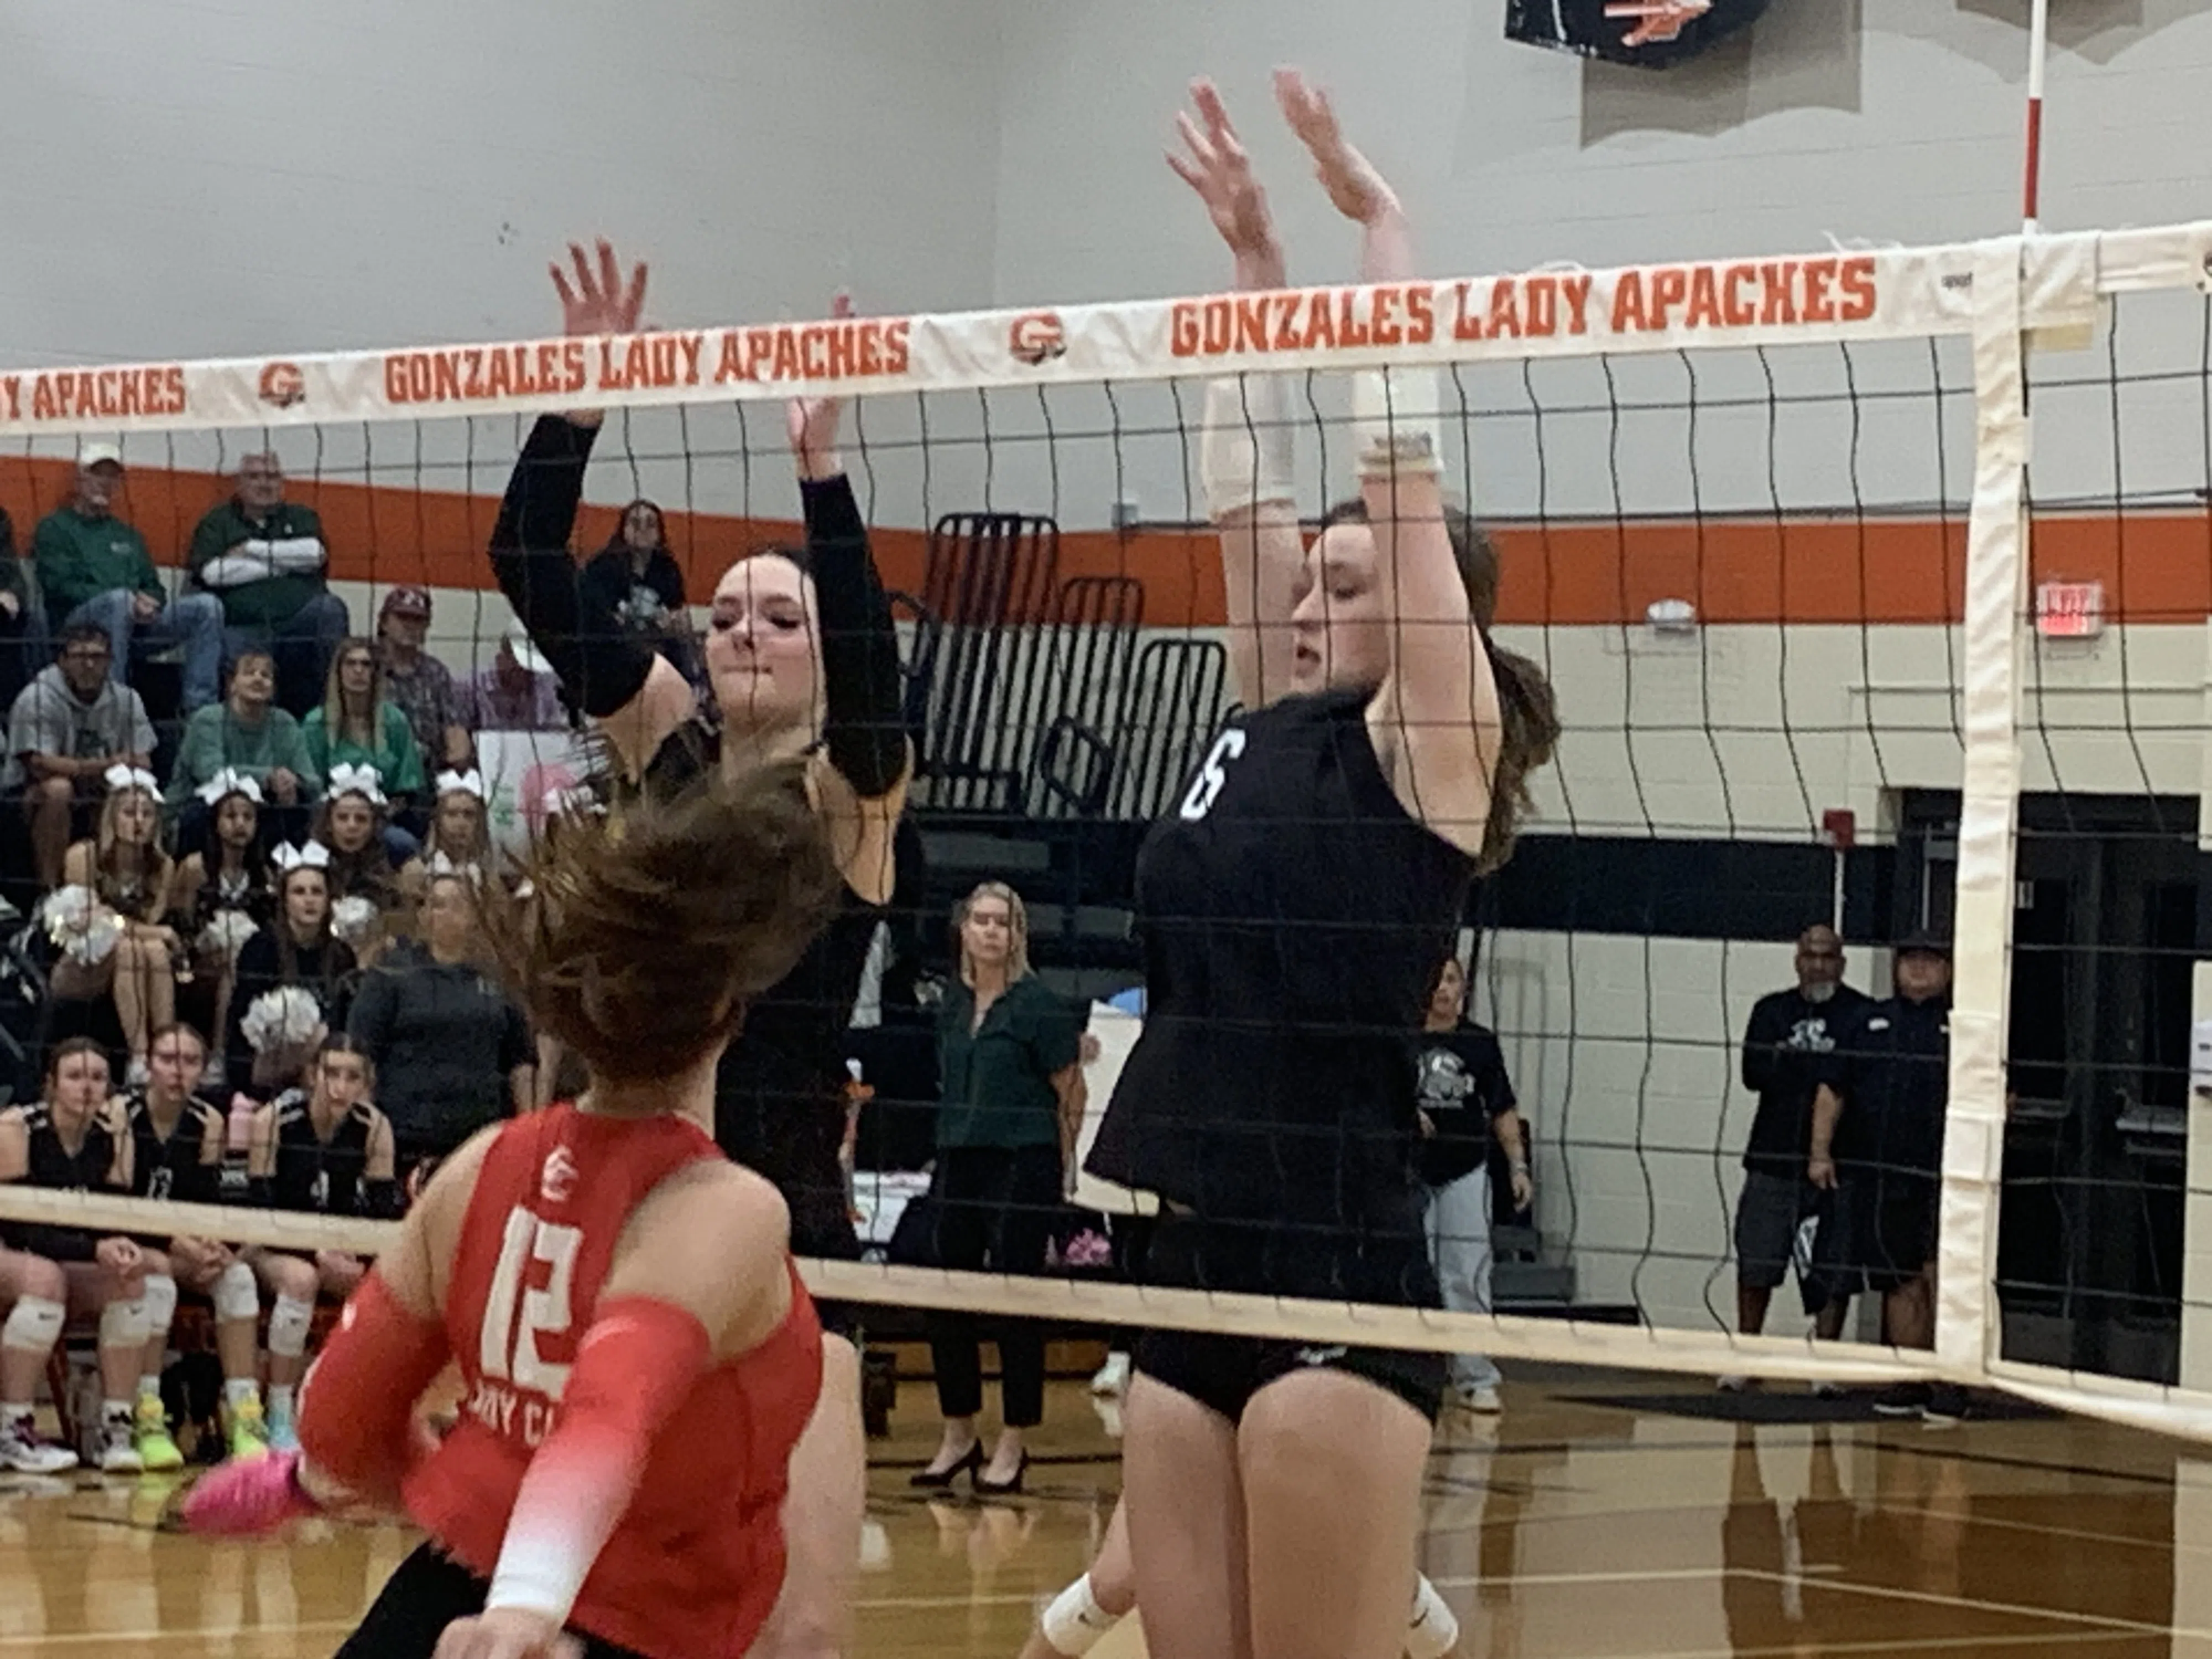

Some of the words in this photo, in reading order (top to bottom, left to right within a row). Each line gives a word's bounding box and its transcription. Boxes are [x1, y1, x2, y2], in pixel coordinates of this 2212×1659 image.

[1171, 286, 1434, 357] GONZALES
[1453, 275, 1590, 341] LADY
[1610, 257, 1876, 332] APACHES
[33, 368, 185, 418] APACHES
[384, 341, 585, 404] GONZALES
[597, 335, 702, 390] LADY
[713, 321, 909, 383] APACHES
[1180, 728, 1246, 819] 6
[480, 1204, 585, 1402] 12
